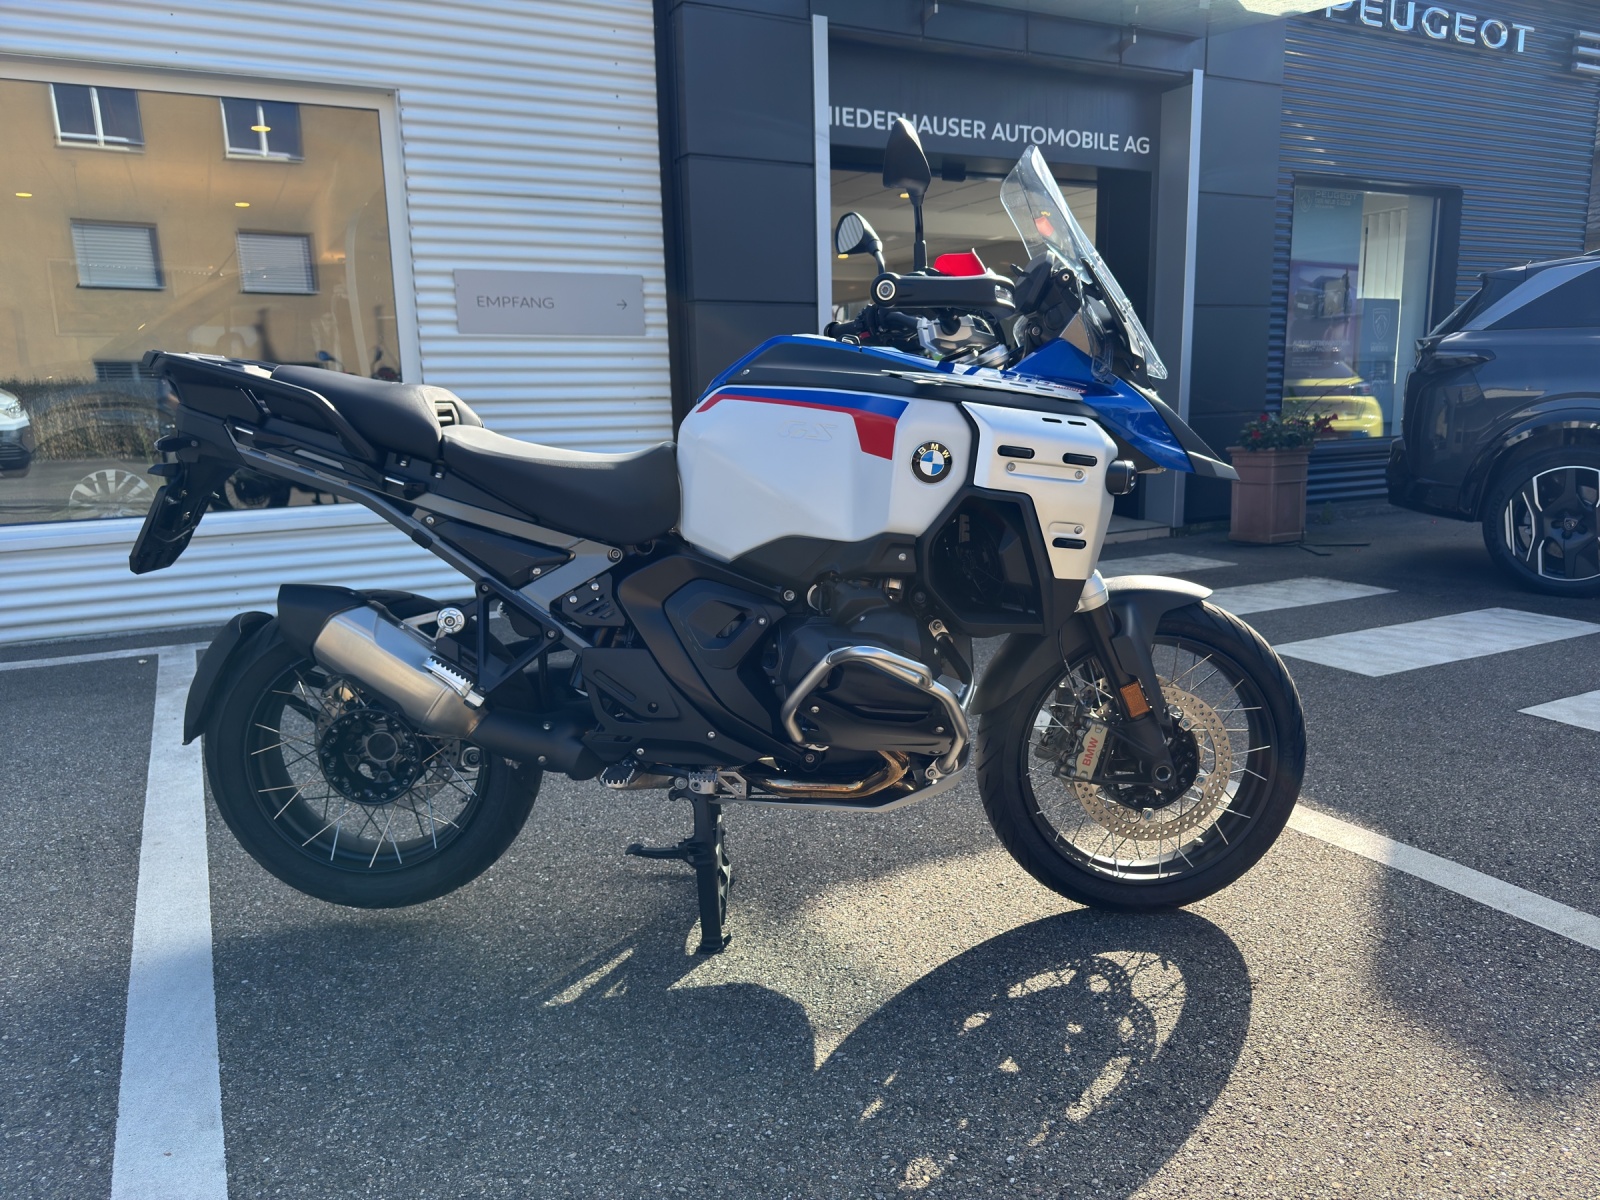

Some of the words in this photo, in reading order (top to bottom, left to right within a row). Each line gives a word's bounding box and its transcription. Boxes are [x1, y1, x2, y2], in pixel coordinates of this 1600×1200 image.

[829, 105, 986, 139] IEDERAUSER
[991, 122, 1120, 152] AUTOMOBILE
[1123, 135, 1151, 154] AG
[476, 295, 555, 309] EMPFANG
[1082, 736, 1099, 766] BMW
